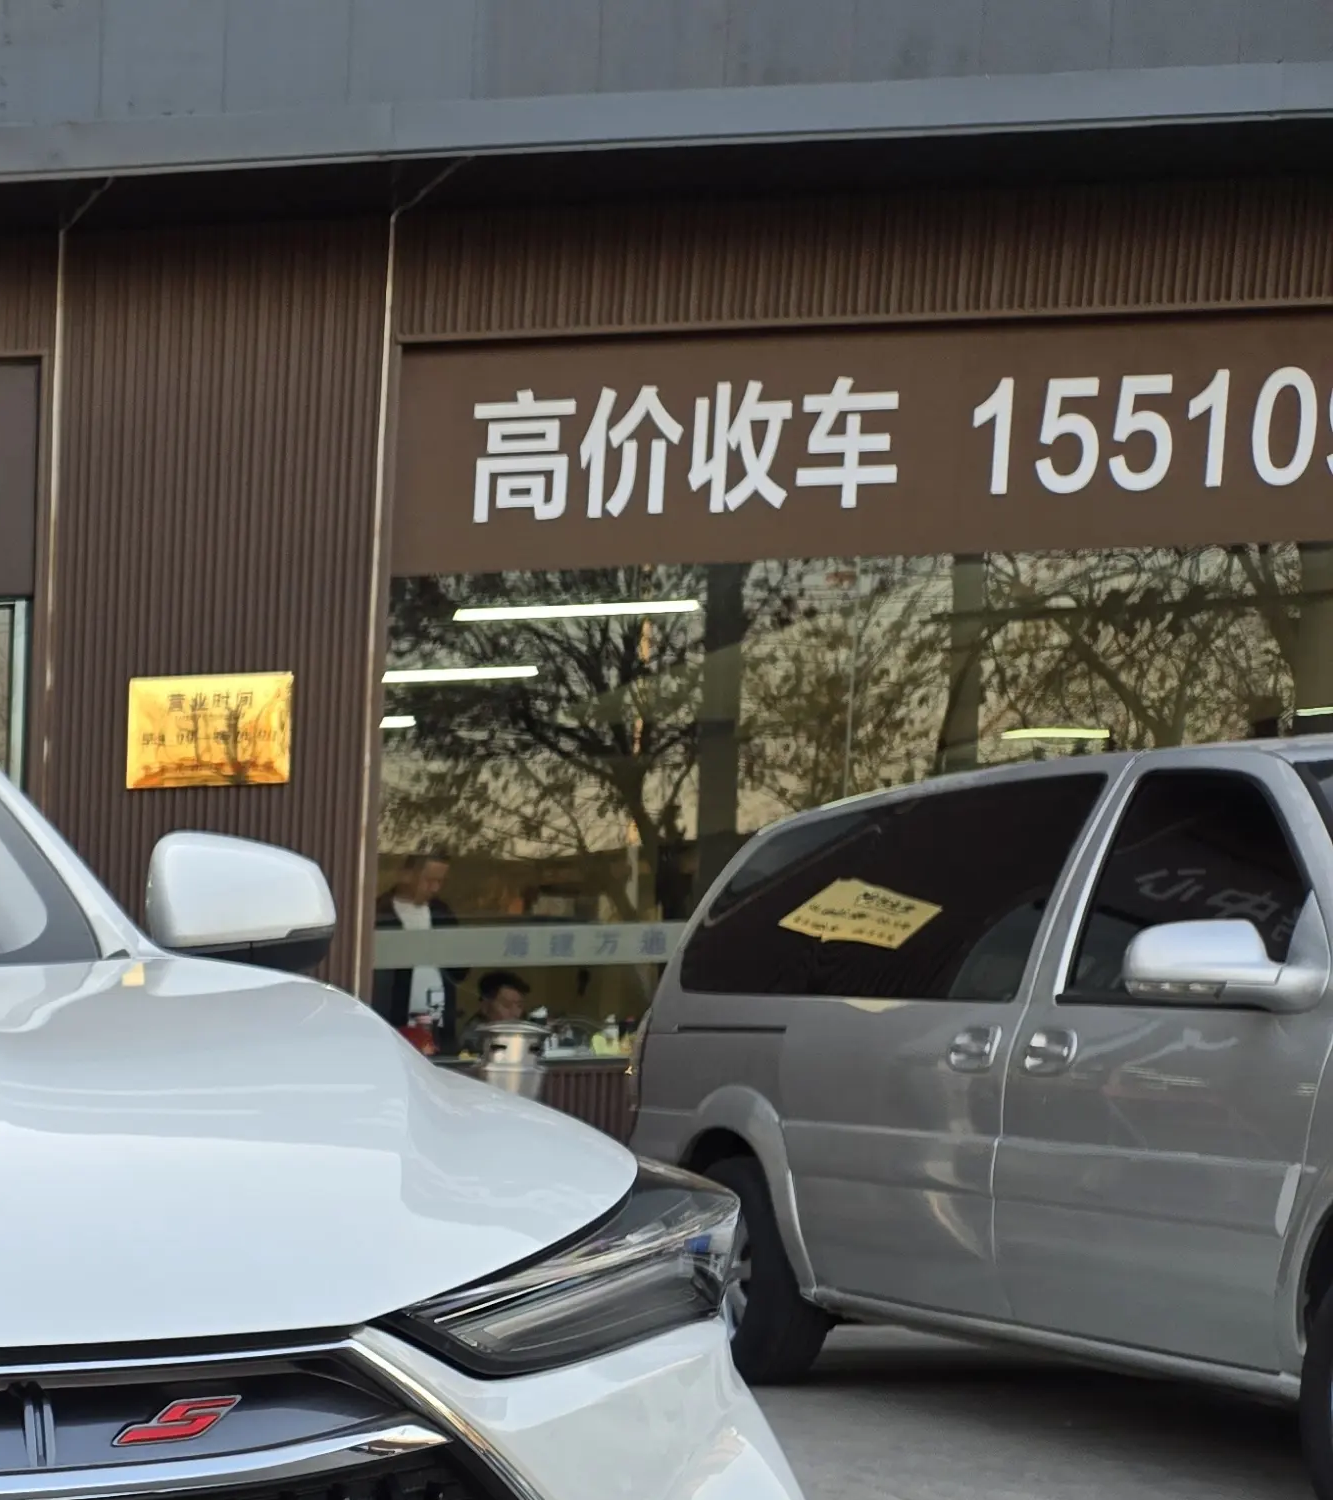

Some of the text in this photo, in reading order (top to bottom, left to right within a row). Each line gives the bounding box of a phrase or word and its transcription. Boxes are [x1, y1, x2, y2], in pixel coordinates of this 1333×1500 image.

[472, 365, 1332, 524] 高价收车 15510
[111, 1394, 243, 1447] S
